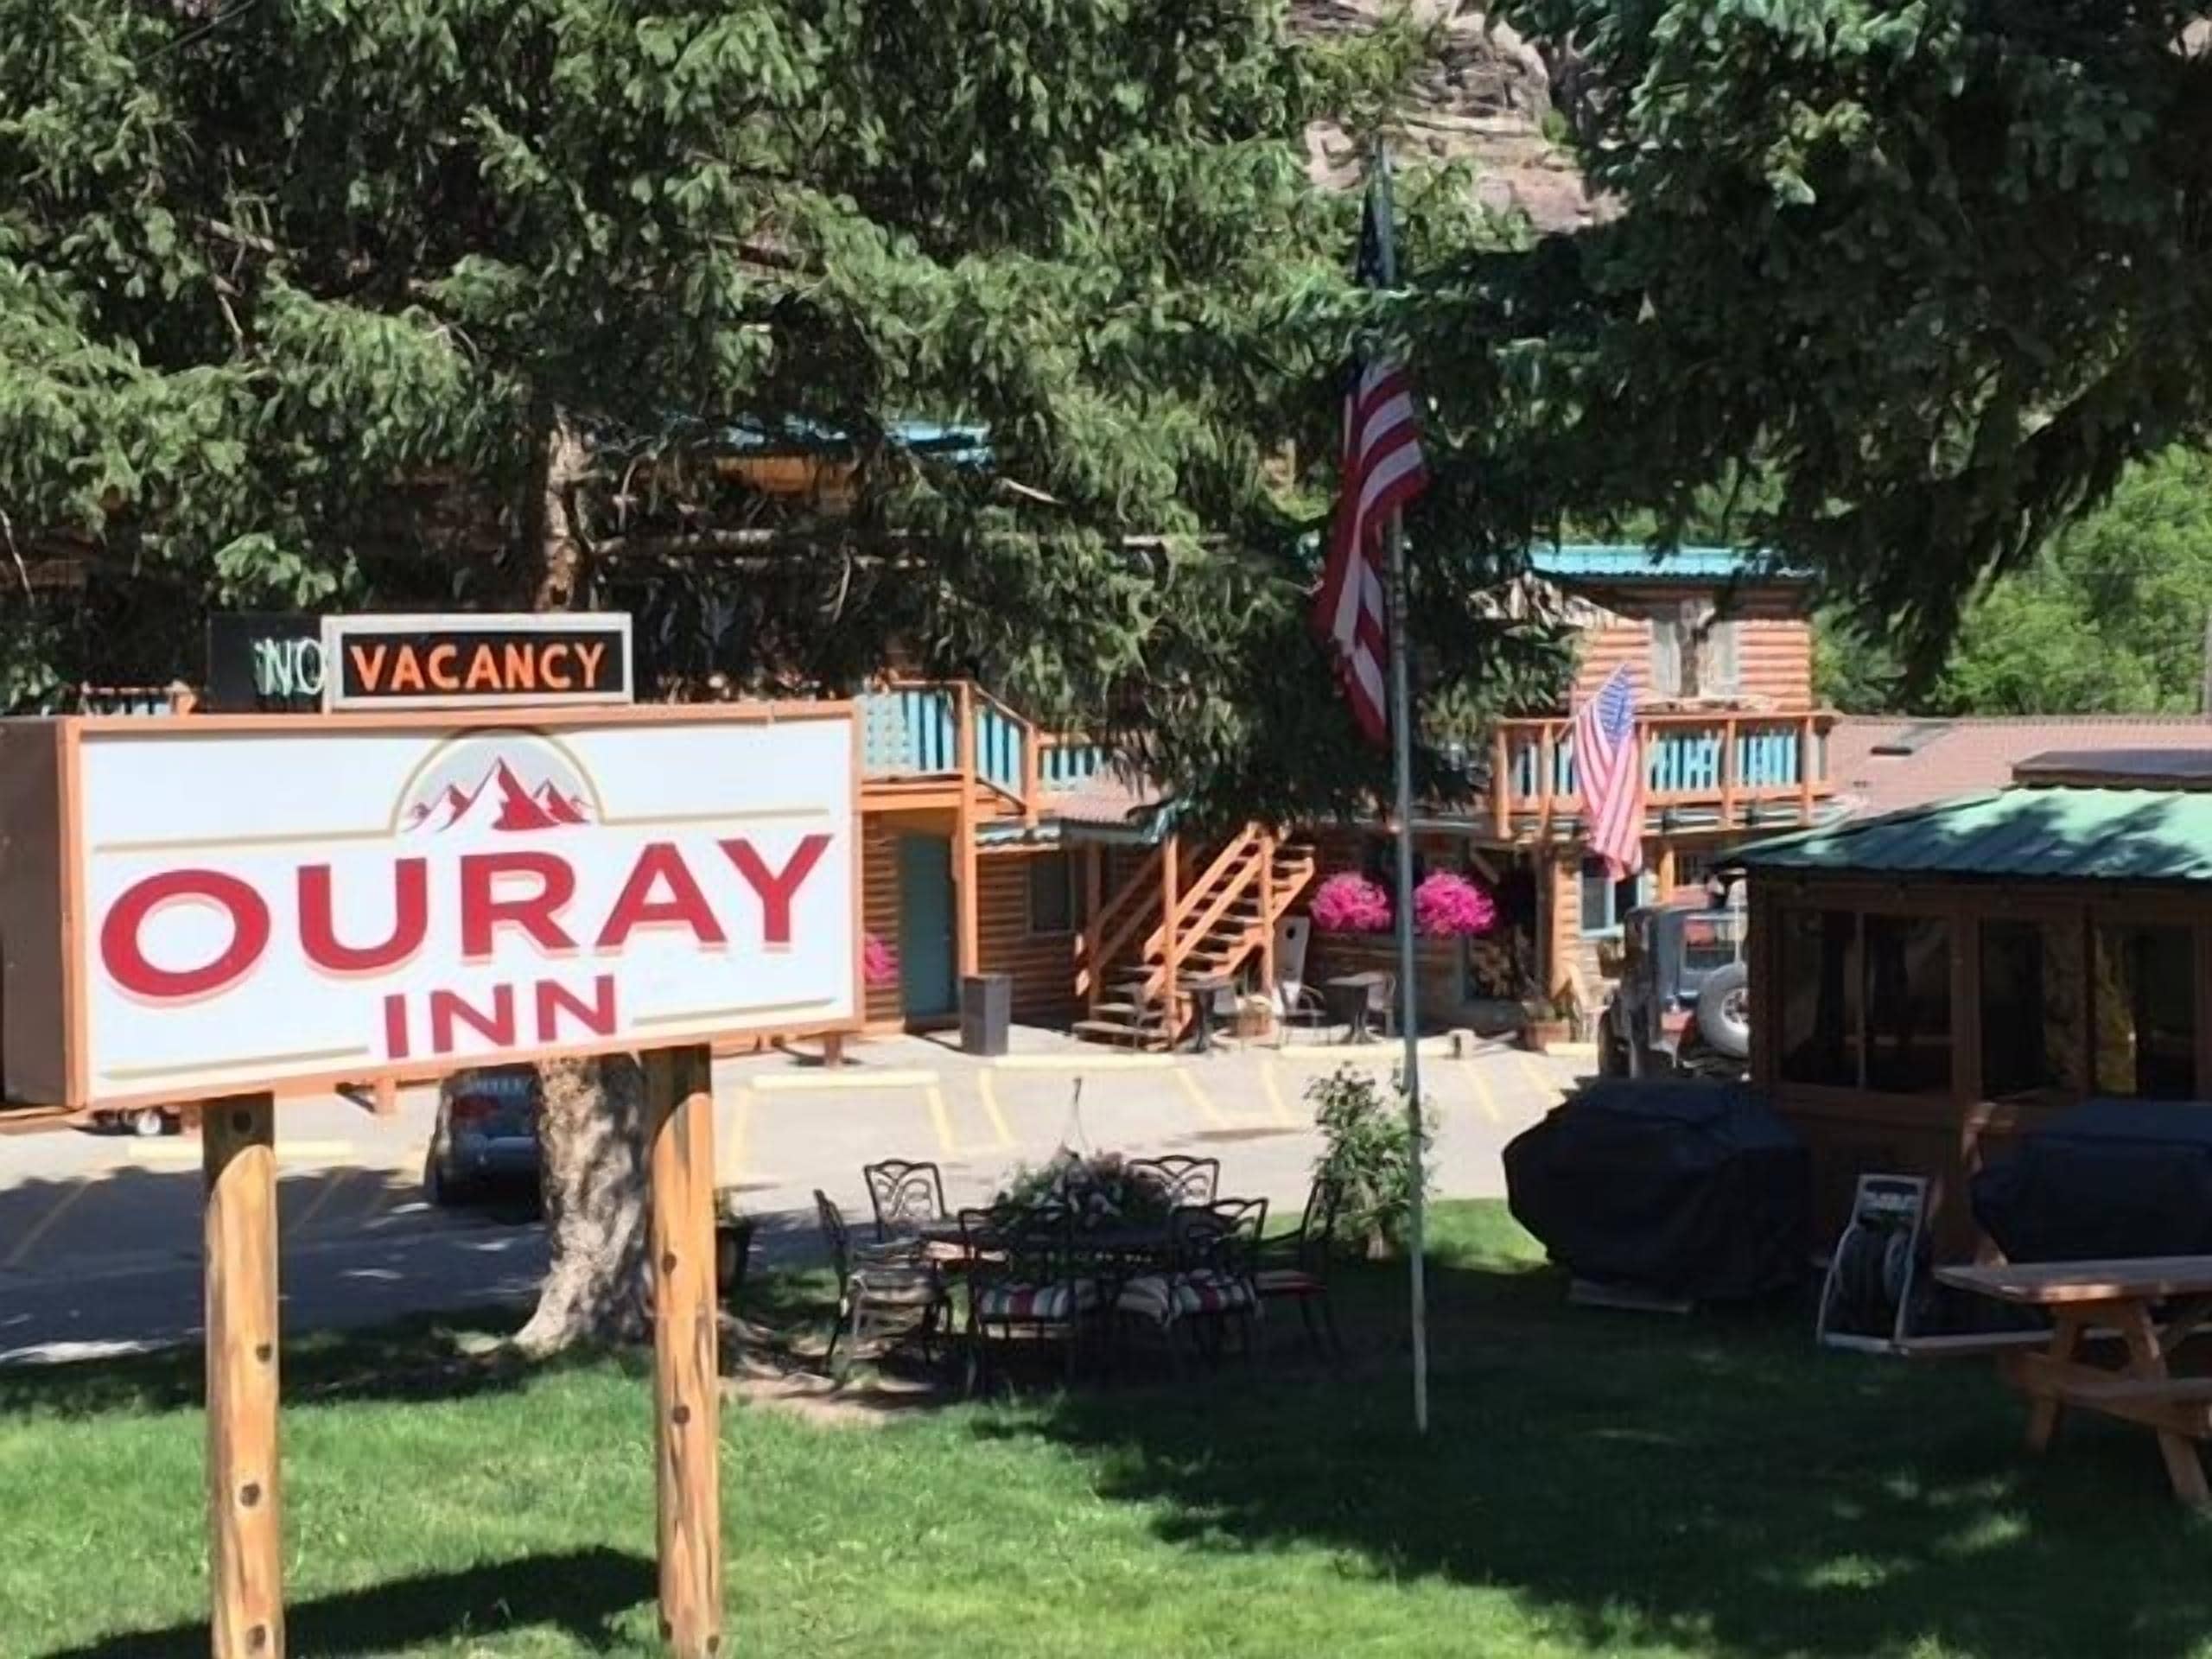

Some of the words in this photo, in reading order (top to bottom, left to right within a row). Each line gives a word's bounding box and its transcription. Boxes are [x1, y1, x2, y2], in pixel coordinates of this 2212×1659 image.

[255, 637, 326, 696] NO
[351, 642, 604, 690] VACANCY
[100, 834, 833, 1001] OURAY
[385, 975, 617, 1059] INN
